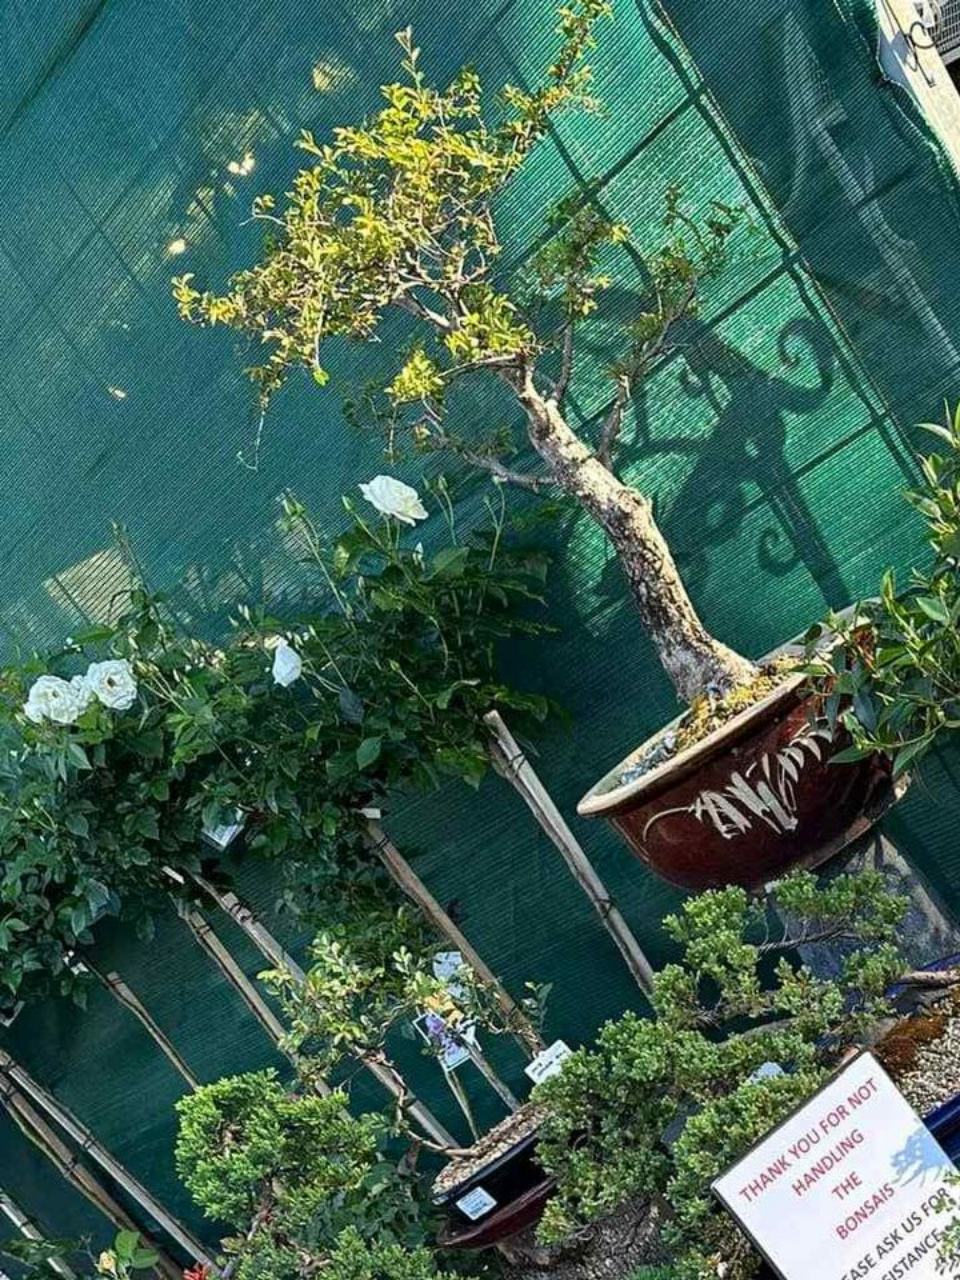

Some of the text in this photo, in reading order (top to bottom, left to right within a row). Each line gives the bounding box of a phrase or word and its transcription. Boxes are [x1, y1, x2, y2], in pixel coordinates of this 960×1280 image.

[739, 1077, 880, 1203] THANK YOU FOR NOT
[791, 1128, 866, 1197] HANDLING
[831, 1171, 864, 1201] THE
[836, 1182, 896, 1240] BONSAIS
[875, 1228, 905, 1265] ASK
[901, 1211, 924, 1235] US
[921, 1186, 951, 1219] FOR
